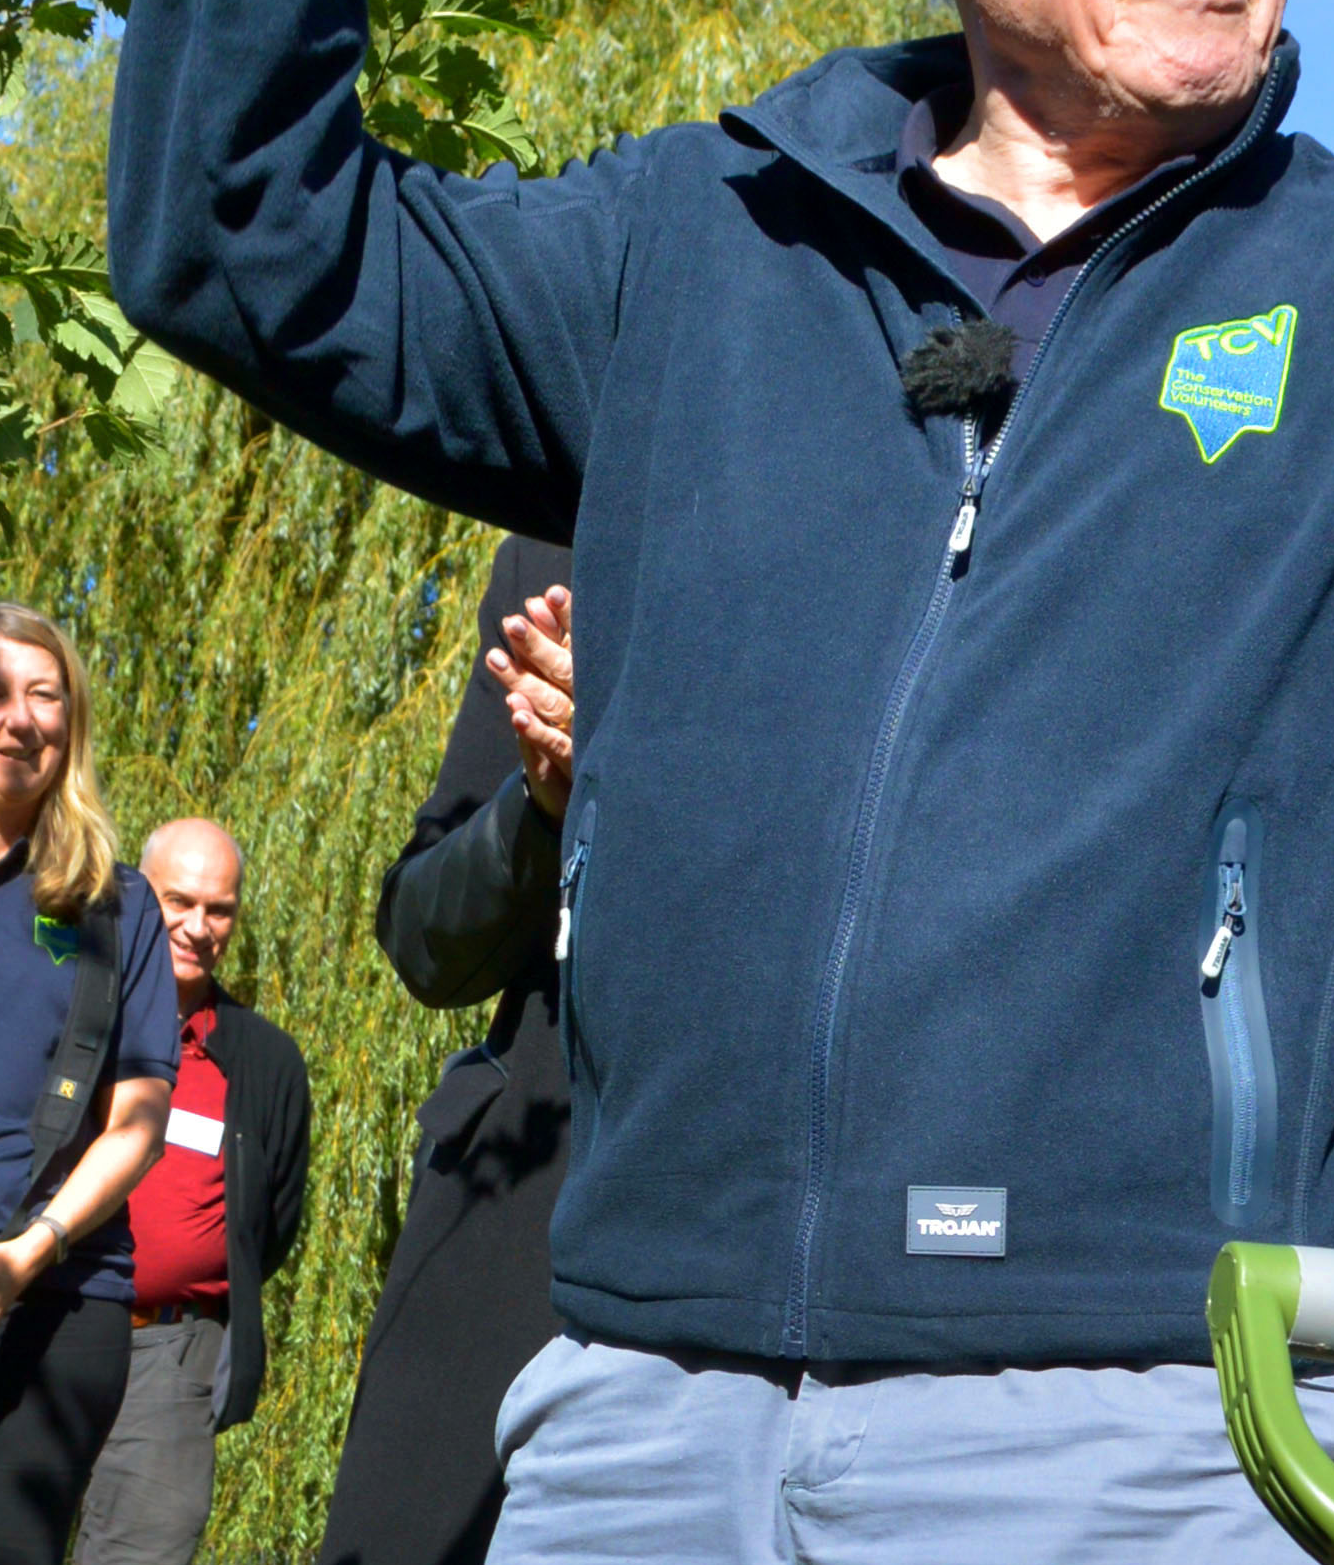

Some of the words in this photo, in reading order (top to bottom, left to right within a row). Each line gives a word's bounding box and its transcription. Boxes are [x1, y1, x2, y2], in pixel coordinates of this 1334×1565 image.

[1185, 313, 1287, 361] TCV
[1176, 369, 1205, 382] The
[1171, 390, 1252, 417] Volunteers
[1172, 381, 1273, 407] Conservation
[917, 1219, 999, 1237] TROJAN
